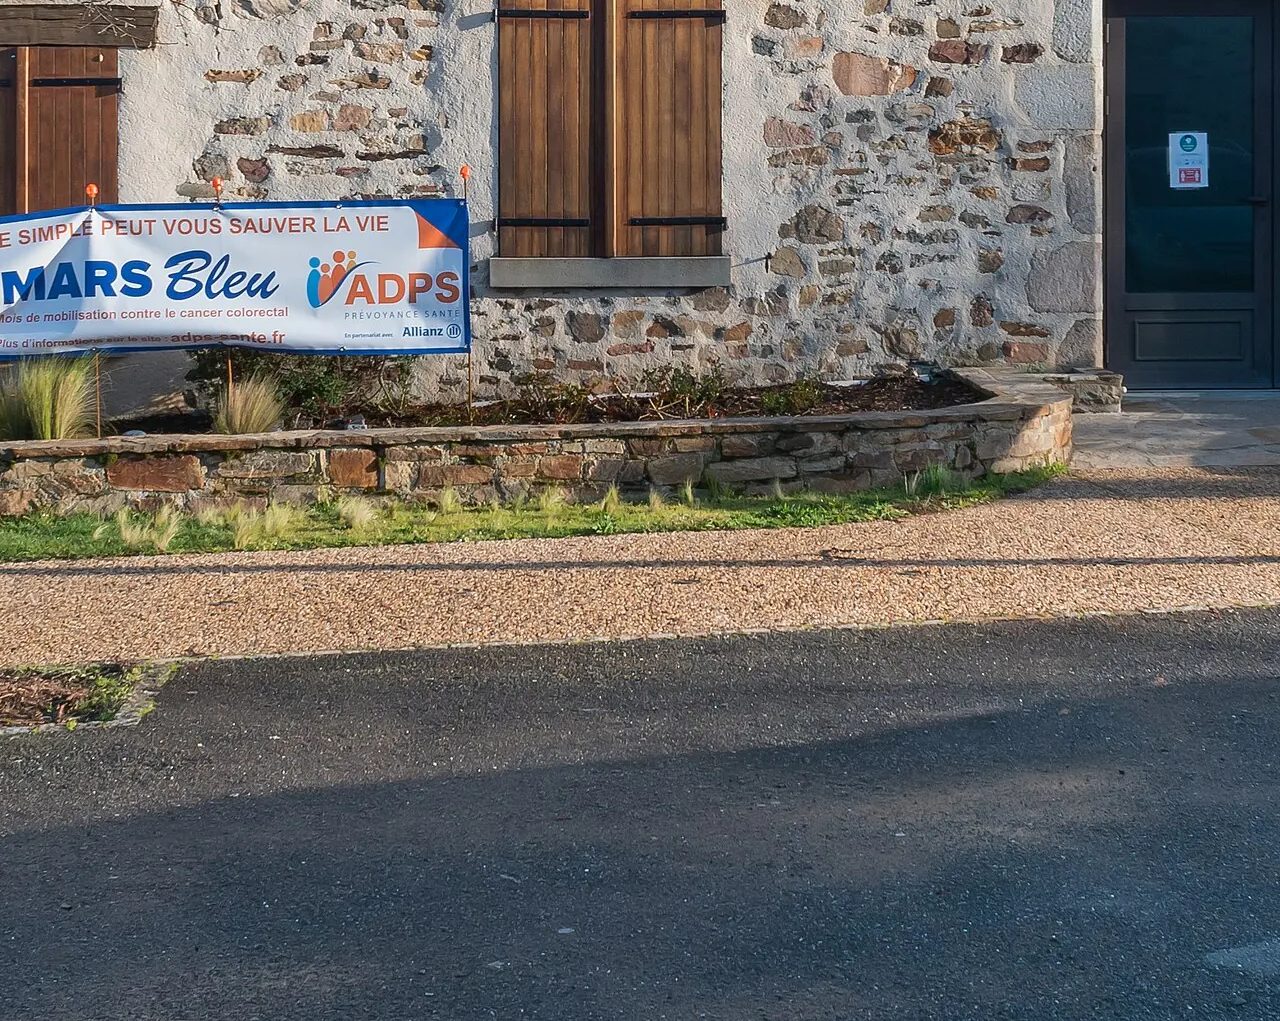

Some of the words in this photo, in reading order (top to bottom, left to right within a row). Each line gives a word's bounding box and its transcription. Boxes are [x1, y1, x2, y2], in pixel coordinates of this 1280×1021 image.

[18, 220, 93, 245] SIMPLE
[101, 219, 156, 236] PEUT
[163, 219, 222, 235] VOUS
[229, 217, 316, 234] SAUVER
[323, 216, 350, 232] LA
[356, 215, 389, 232] VIE
[1, 260, 153, 305] MARS
[164, 250, 279, 300] Bleu
[344, 272, 460, 305] ADPS
[26, 313, 39, 323] de
[43, 309, 116, 322] mobilisation
[121, 309, 161, 320] contre
[165, 308, 176, 318] le
[180, 309, 223, 318] cancer
[226, 307, 289, 318] colorectal
[344, 309, 419, 320] PRÉVOYANCE
[425, 308, 460, 318] SANTÉ
[402, 326, 443, 337] Allianz
